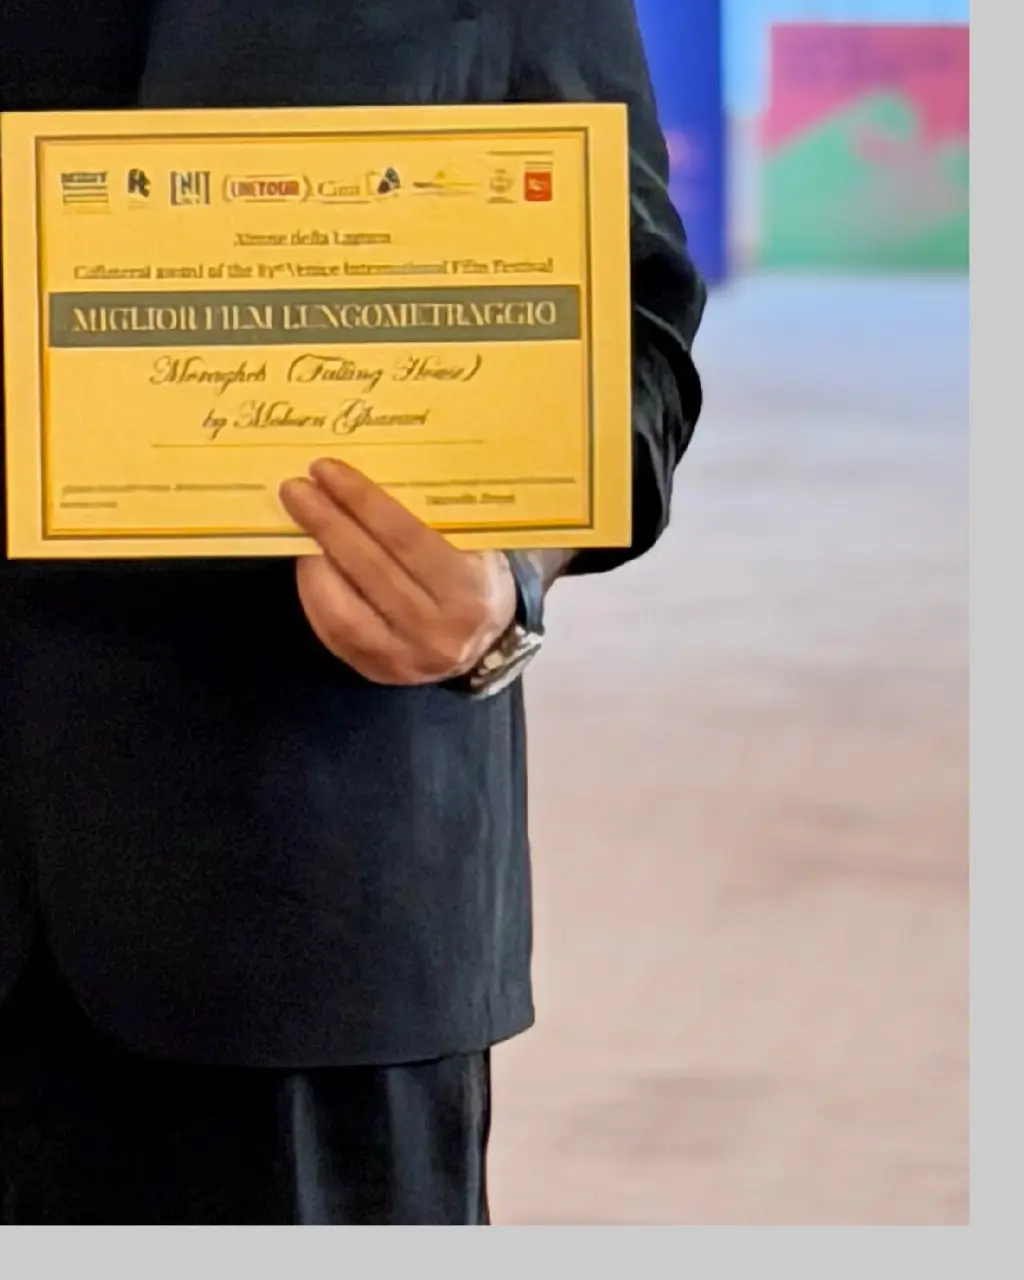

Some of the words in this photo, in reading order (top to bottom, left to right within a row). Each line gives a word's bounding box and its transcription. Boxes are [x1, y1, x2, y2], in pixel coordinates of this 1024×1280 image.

[208, 263, 224, 279] of
[228, 262, 253, 278] the
[73, 304, 198, 332] MIGLIOR
[282, 300, 557, 330] LUNGOMETRAGGIO
[202, 408, 228, 440] by
